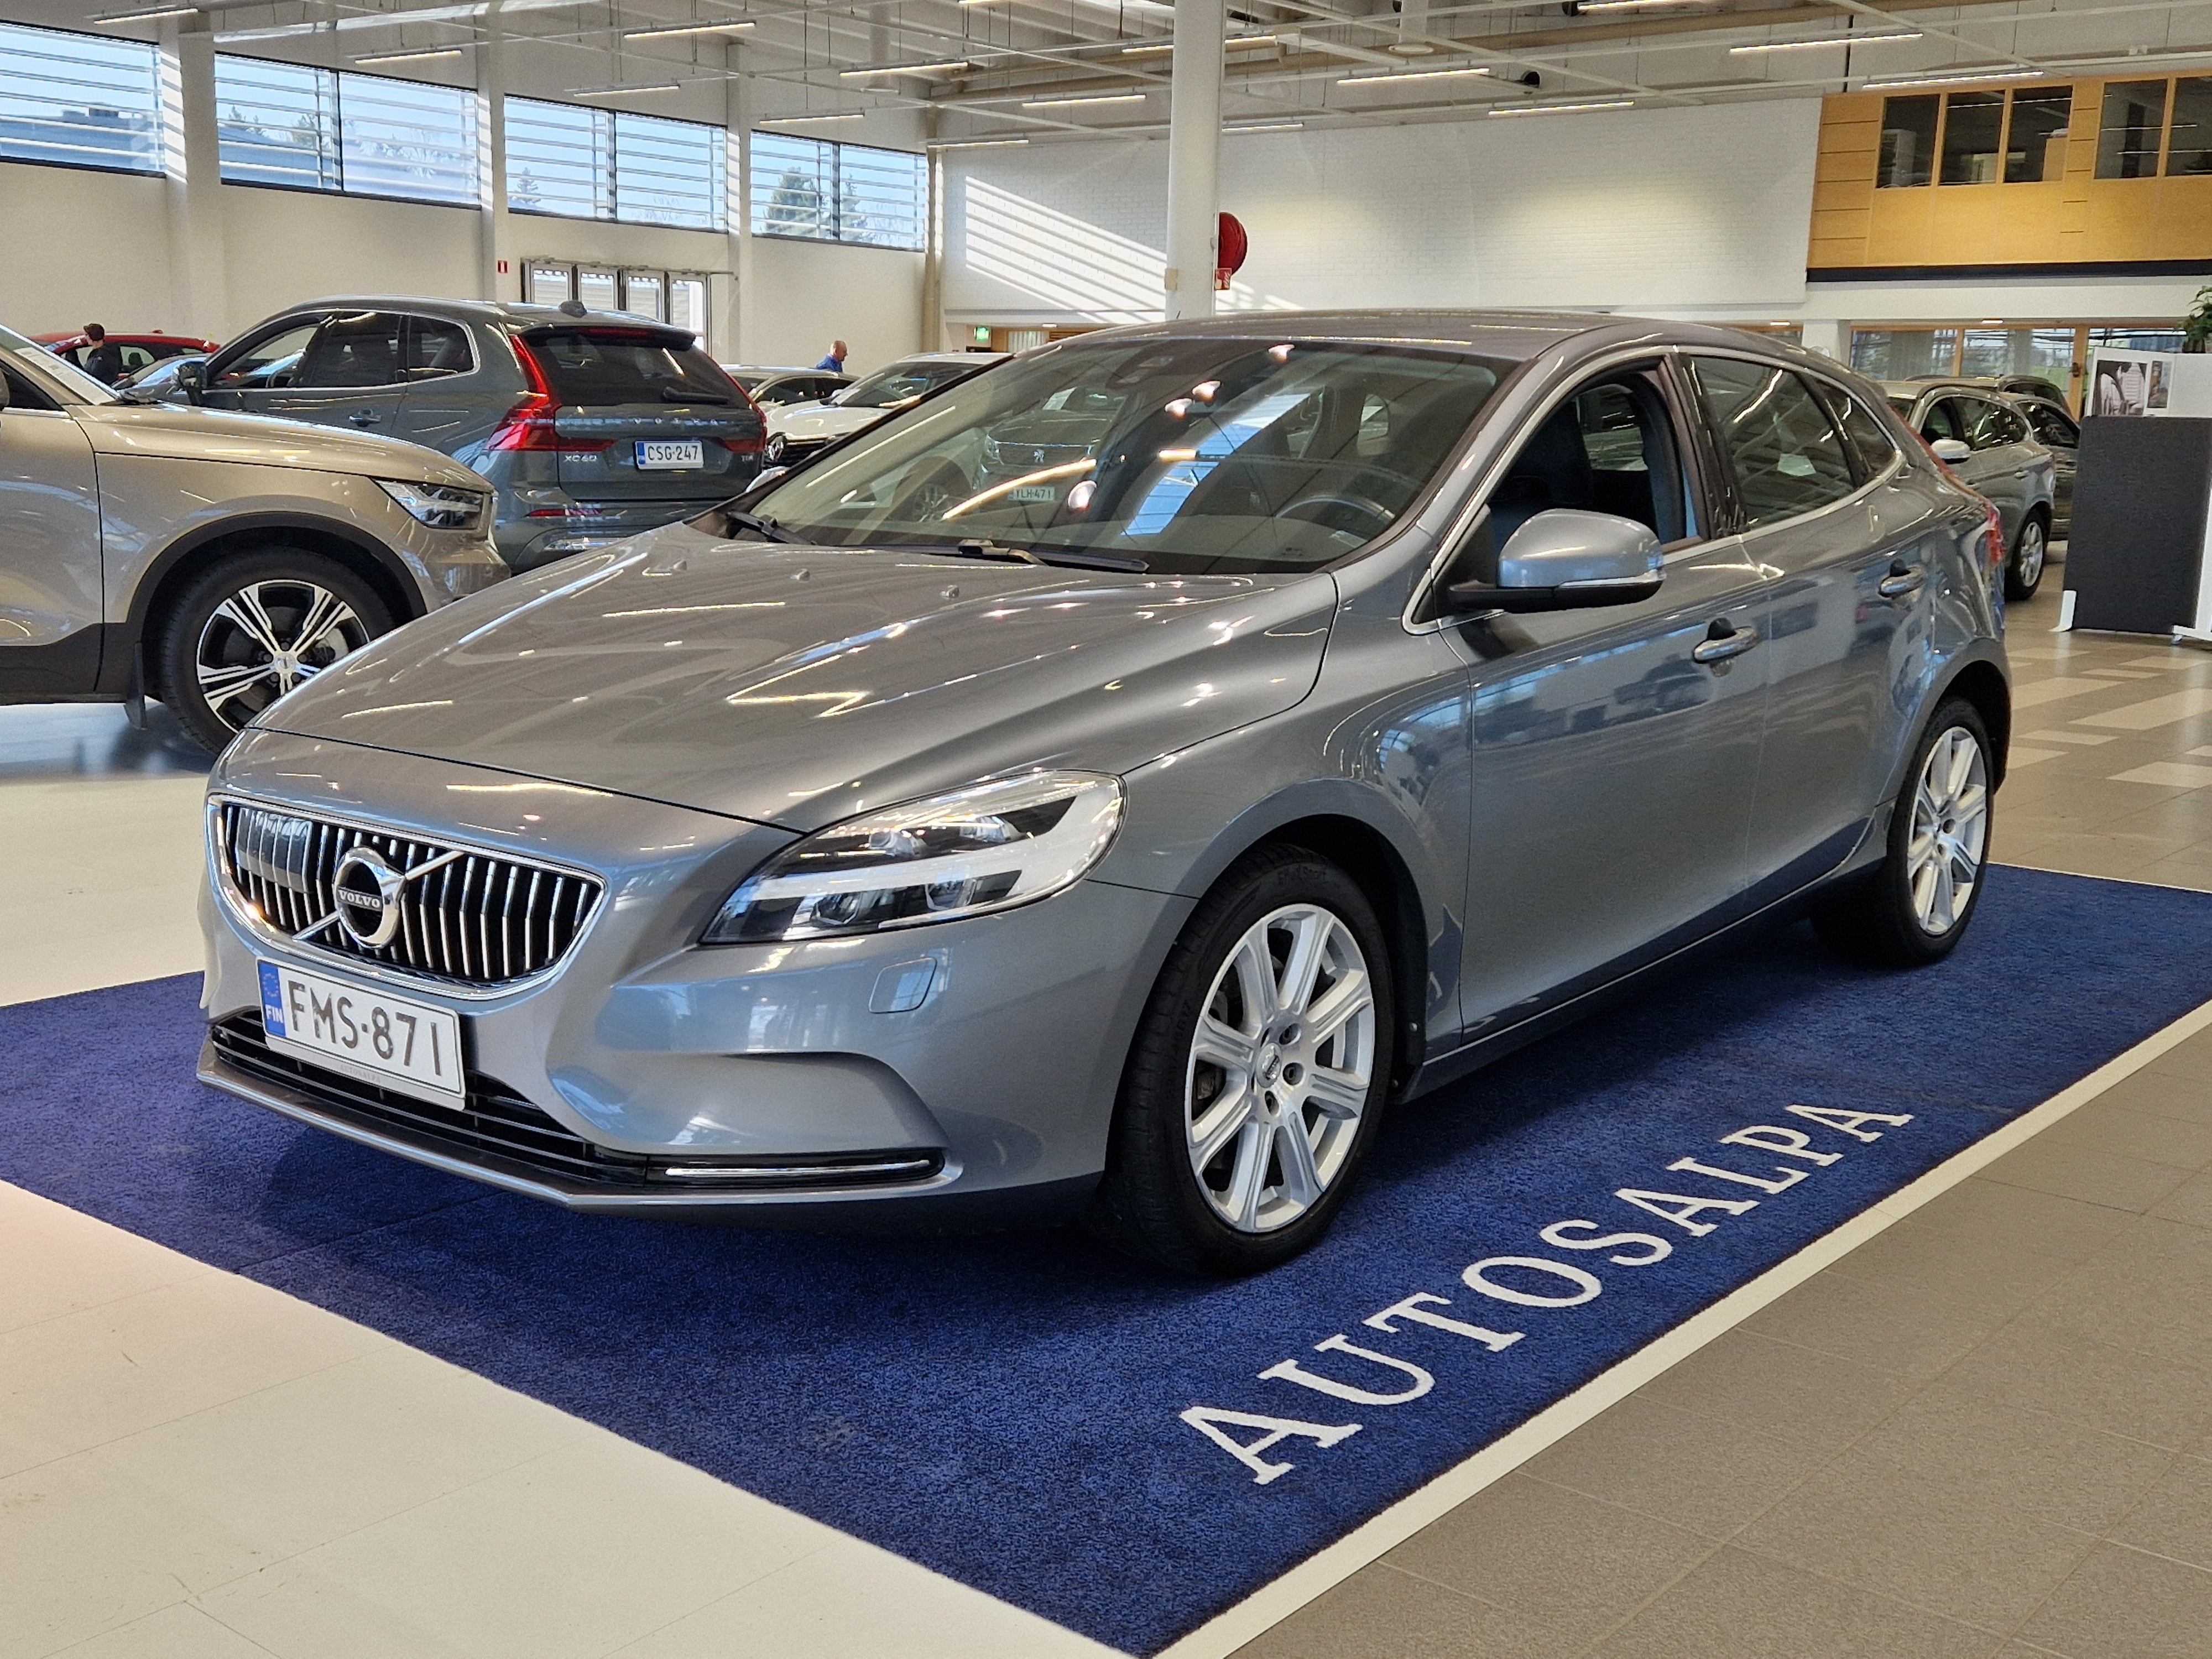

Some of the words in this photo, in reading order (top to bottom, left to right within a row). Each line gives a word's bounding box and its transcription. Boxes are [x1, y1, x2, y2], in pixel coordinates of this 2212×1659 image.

[648, 445, 698, 461] CSG-247
[338, 889, 380, 908] VOLVO
[265, 1004, 284, 1024] FIN
[288, 980, 442, 1076] FMS-871
[1179, 1104, 1916, 1485] AUTOSALPA
